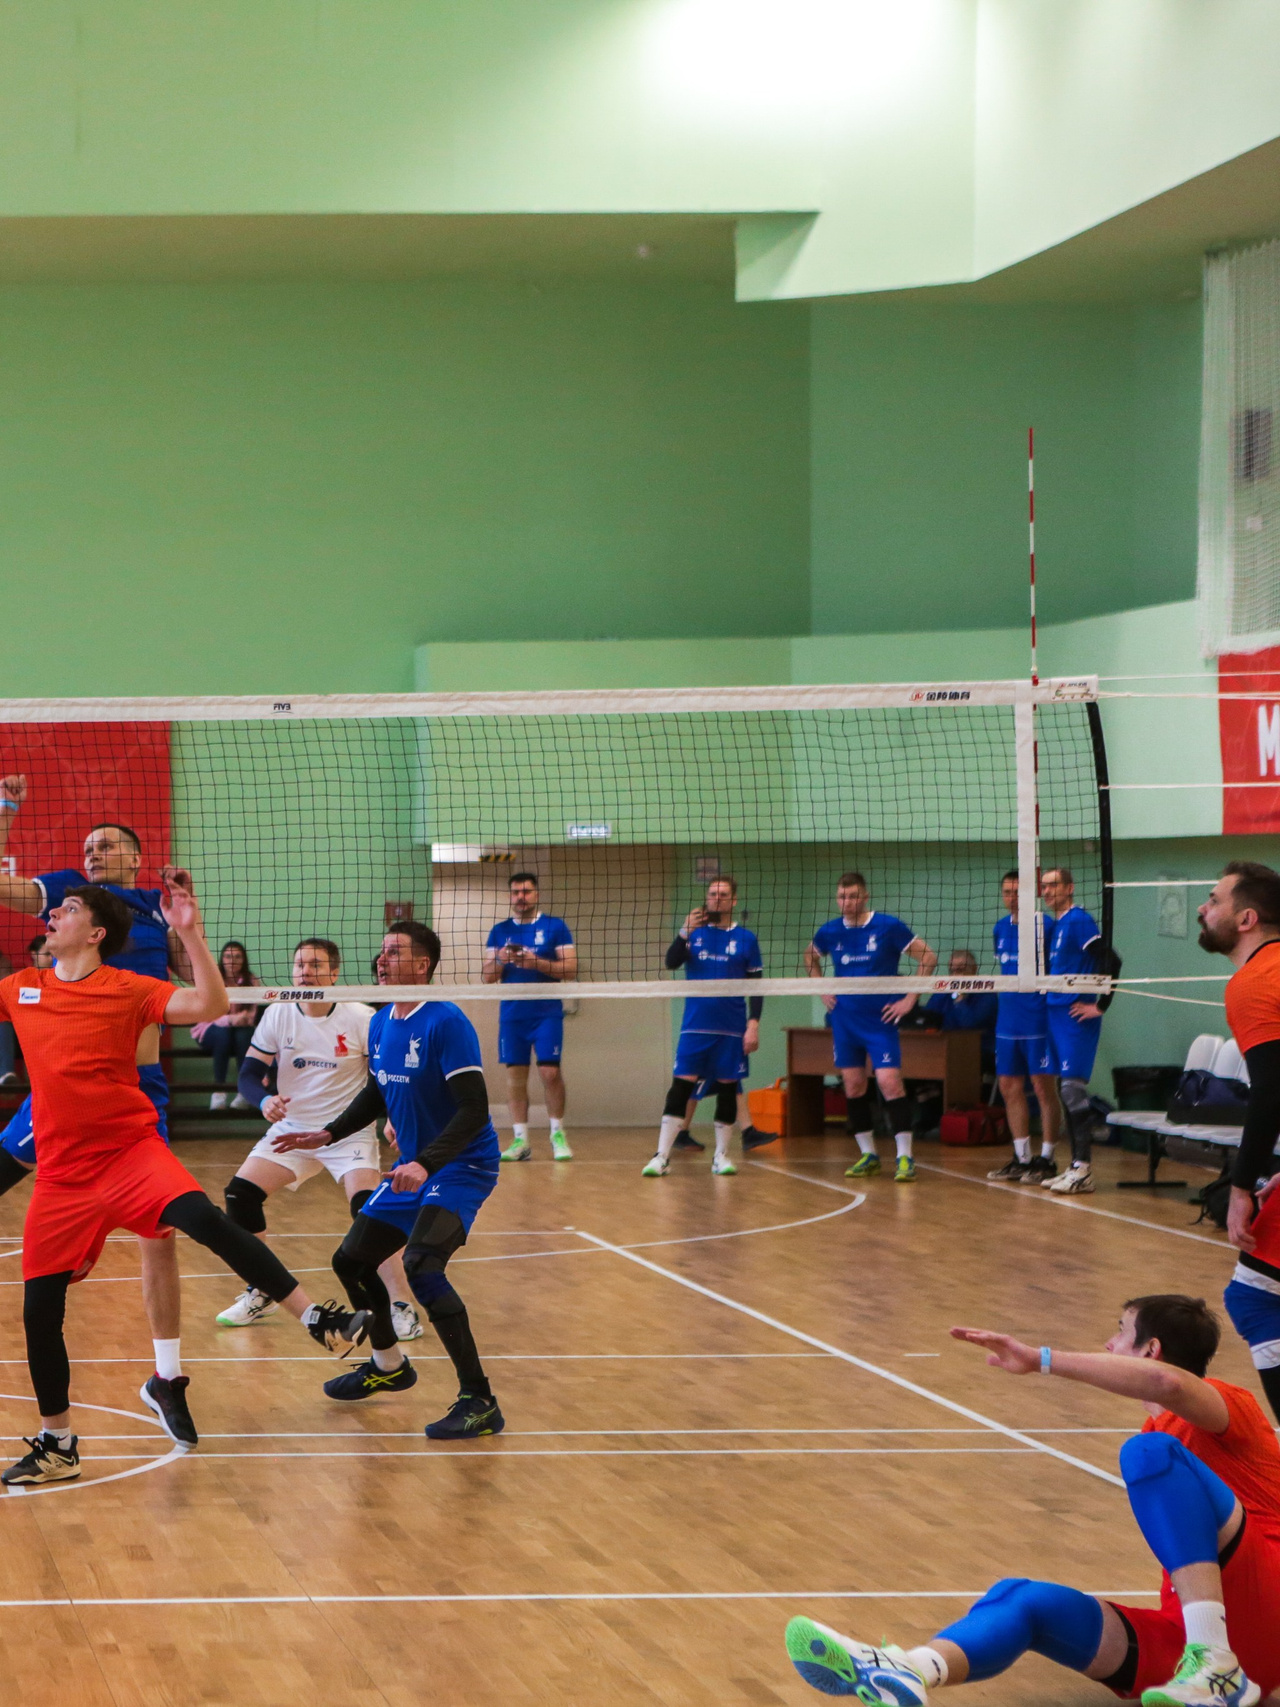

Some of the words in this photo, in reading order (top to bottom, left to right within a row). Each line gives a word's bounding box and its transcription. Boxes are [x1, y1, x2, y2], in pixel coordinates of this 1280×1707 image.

[273, 702, 291, 711] FIVB
[307, 1060, 337, 1069] РОССЕТИ
[387, 1074, 410, 1084] РОССЕТИ
